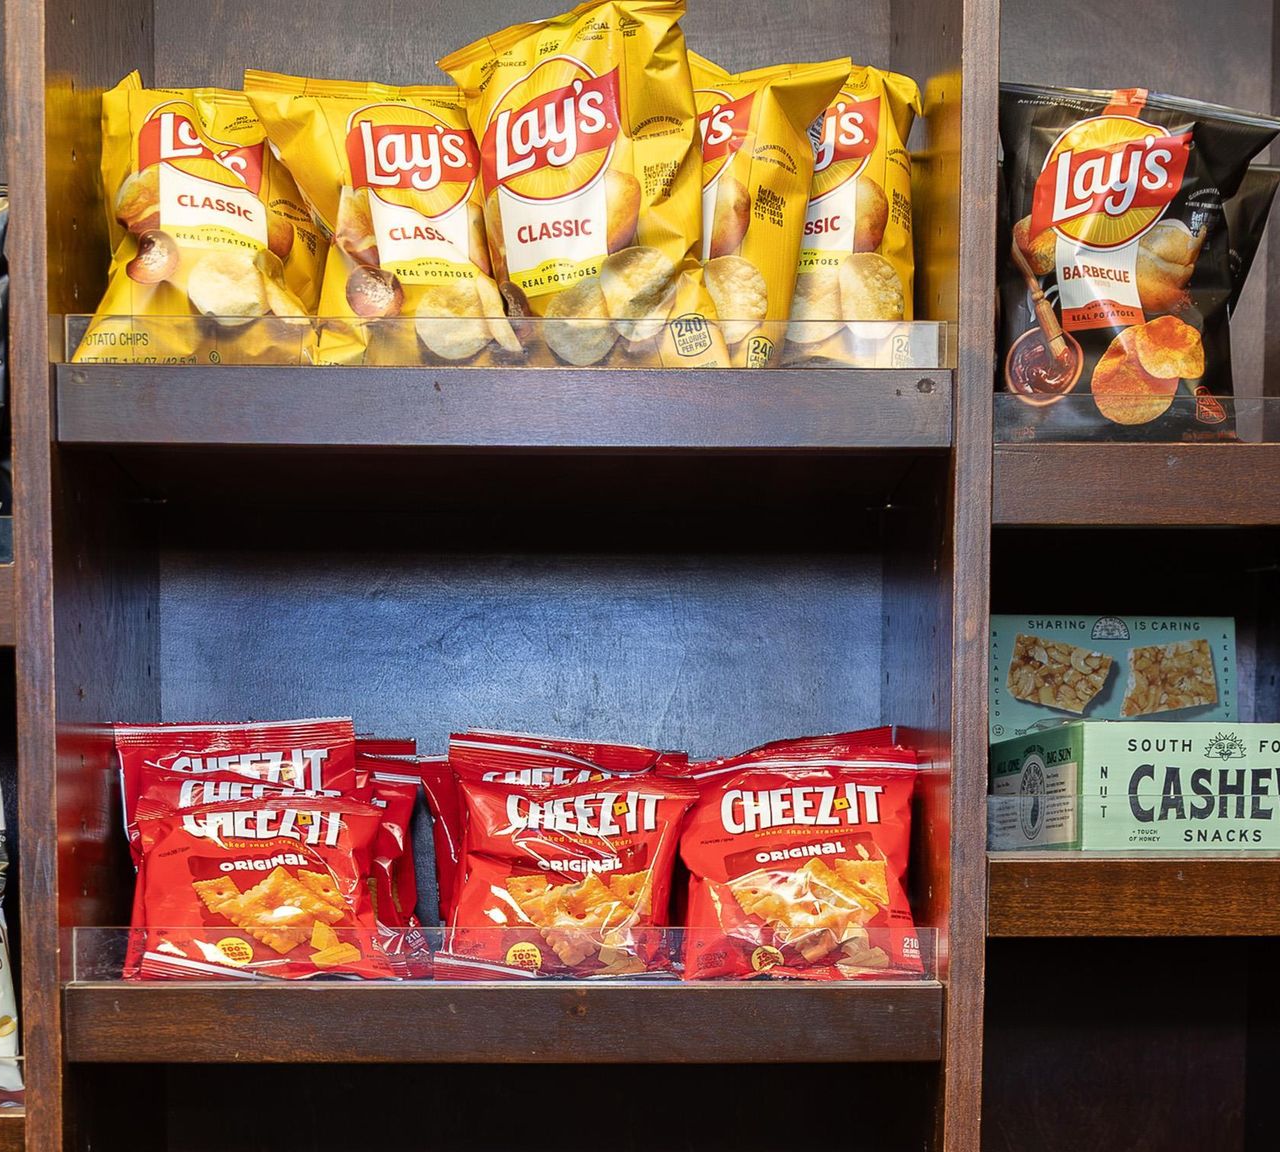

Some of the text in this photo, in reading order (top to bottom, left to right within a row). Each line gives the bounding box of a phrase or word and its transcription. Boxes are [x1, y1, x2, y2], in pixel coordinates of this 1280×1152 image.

[497, 78, 607, 180] Lay's
[359, 120, 469, 191] Lay's
[1052, 134, 1173, 224] Lay's
[177, 194, 254, 222] CLASSIC
[517, 218, 593, 245] CLASSIC
[176, 232, 259, 250] REAL POTATOES
[396, 268, 474, 279] REAL POTATOES
[522, 265, 598, 289] REAL POTATOES
[1063, 264, 1131, 284] BARBECUE
[1072, 309, 1136, 322] REAL POTATOES
[675, 316, 703, 339] 240
[119, 332, 149, 346] CHIPS
[678, 333, 708, 347] CALORIES
[681, 341, 708, 354] PER PKG
[1028, 620, 1087, 631] SHARING
[1134, 620, 1201, 632] IS CARING
[1127, 738, 1193, 753] SOUTH
[1183, 829, 1263, 843] SNACKS
[904, 936, 920, 949] 210
